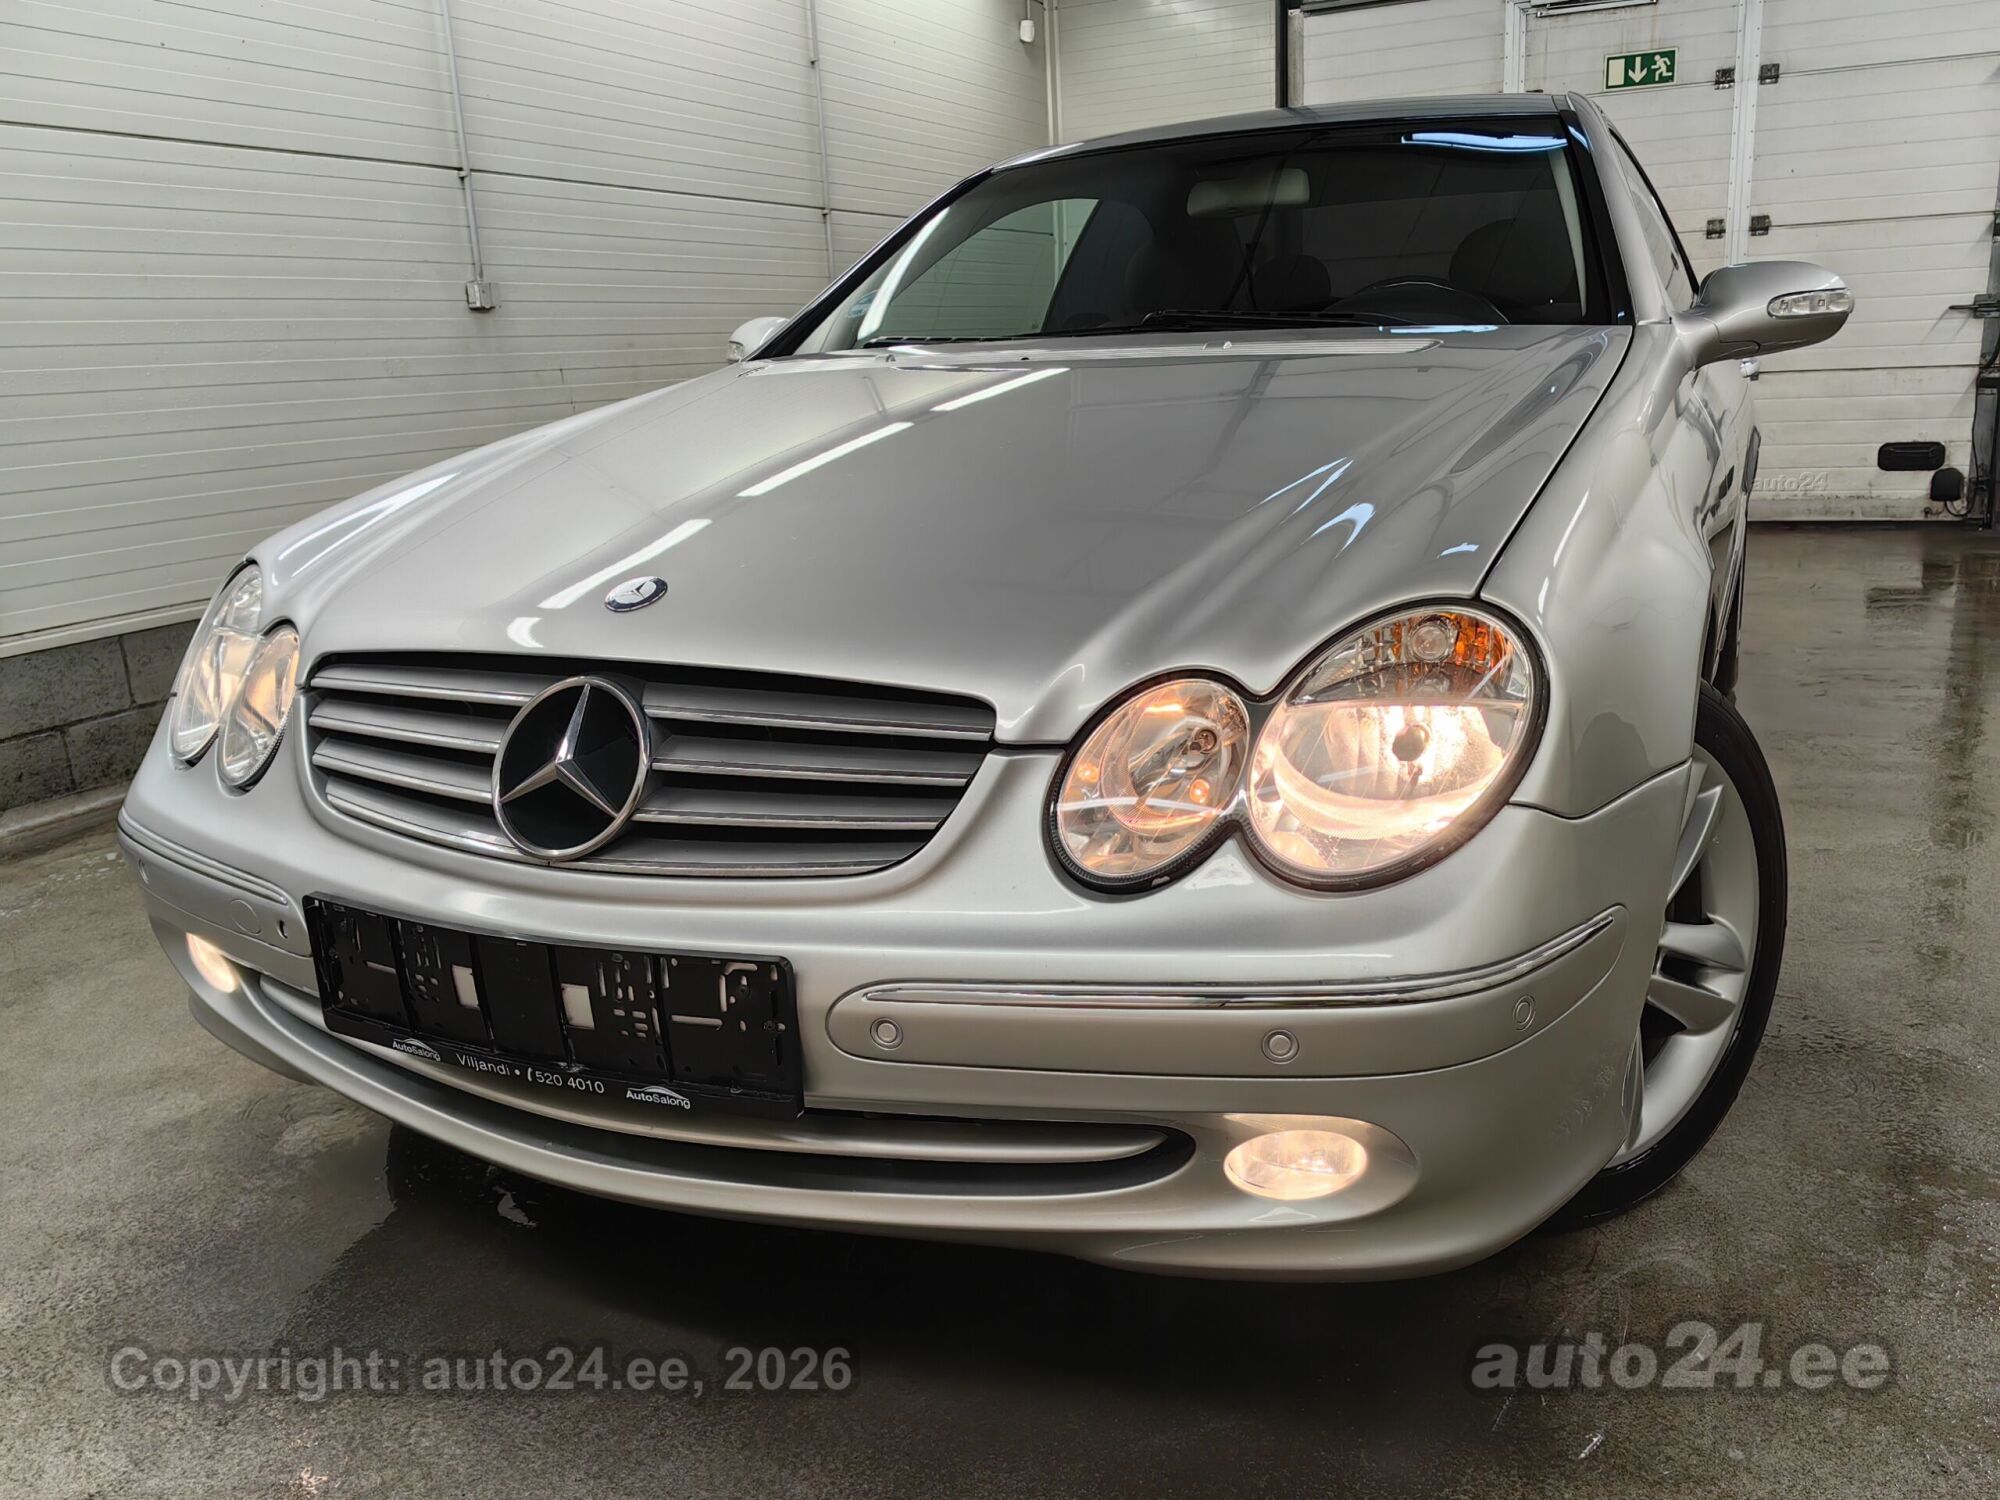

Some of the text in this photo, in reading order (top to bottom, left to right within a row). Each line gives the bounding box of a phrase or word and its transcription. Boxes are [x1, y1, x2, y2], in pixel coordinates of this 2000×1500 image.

[392, 1041, 441, 1062] AutoSalong
[456, 1053, 511, 1076] Viljandi
[567, 1077, 605, 1094] 4010
[626, 1090, 691, 1110] AutoSalong
